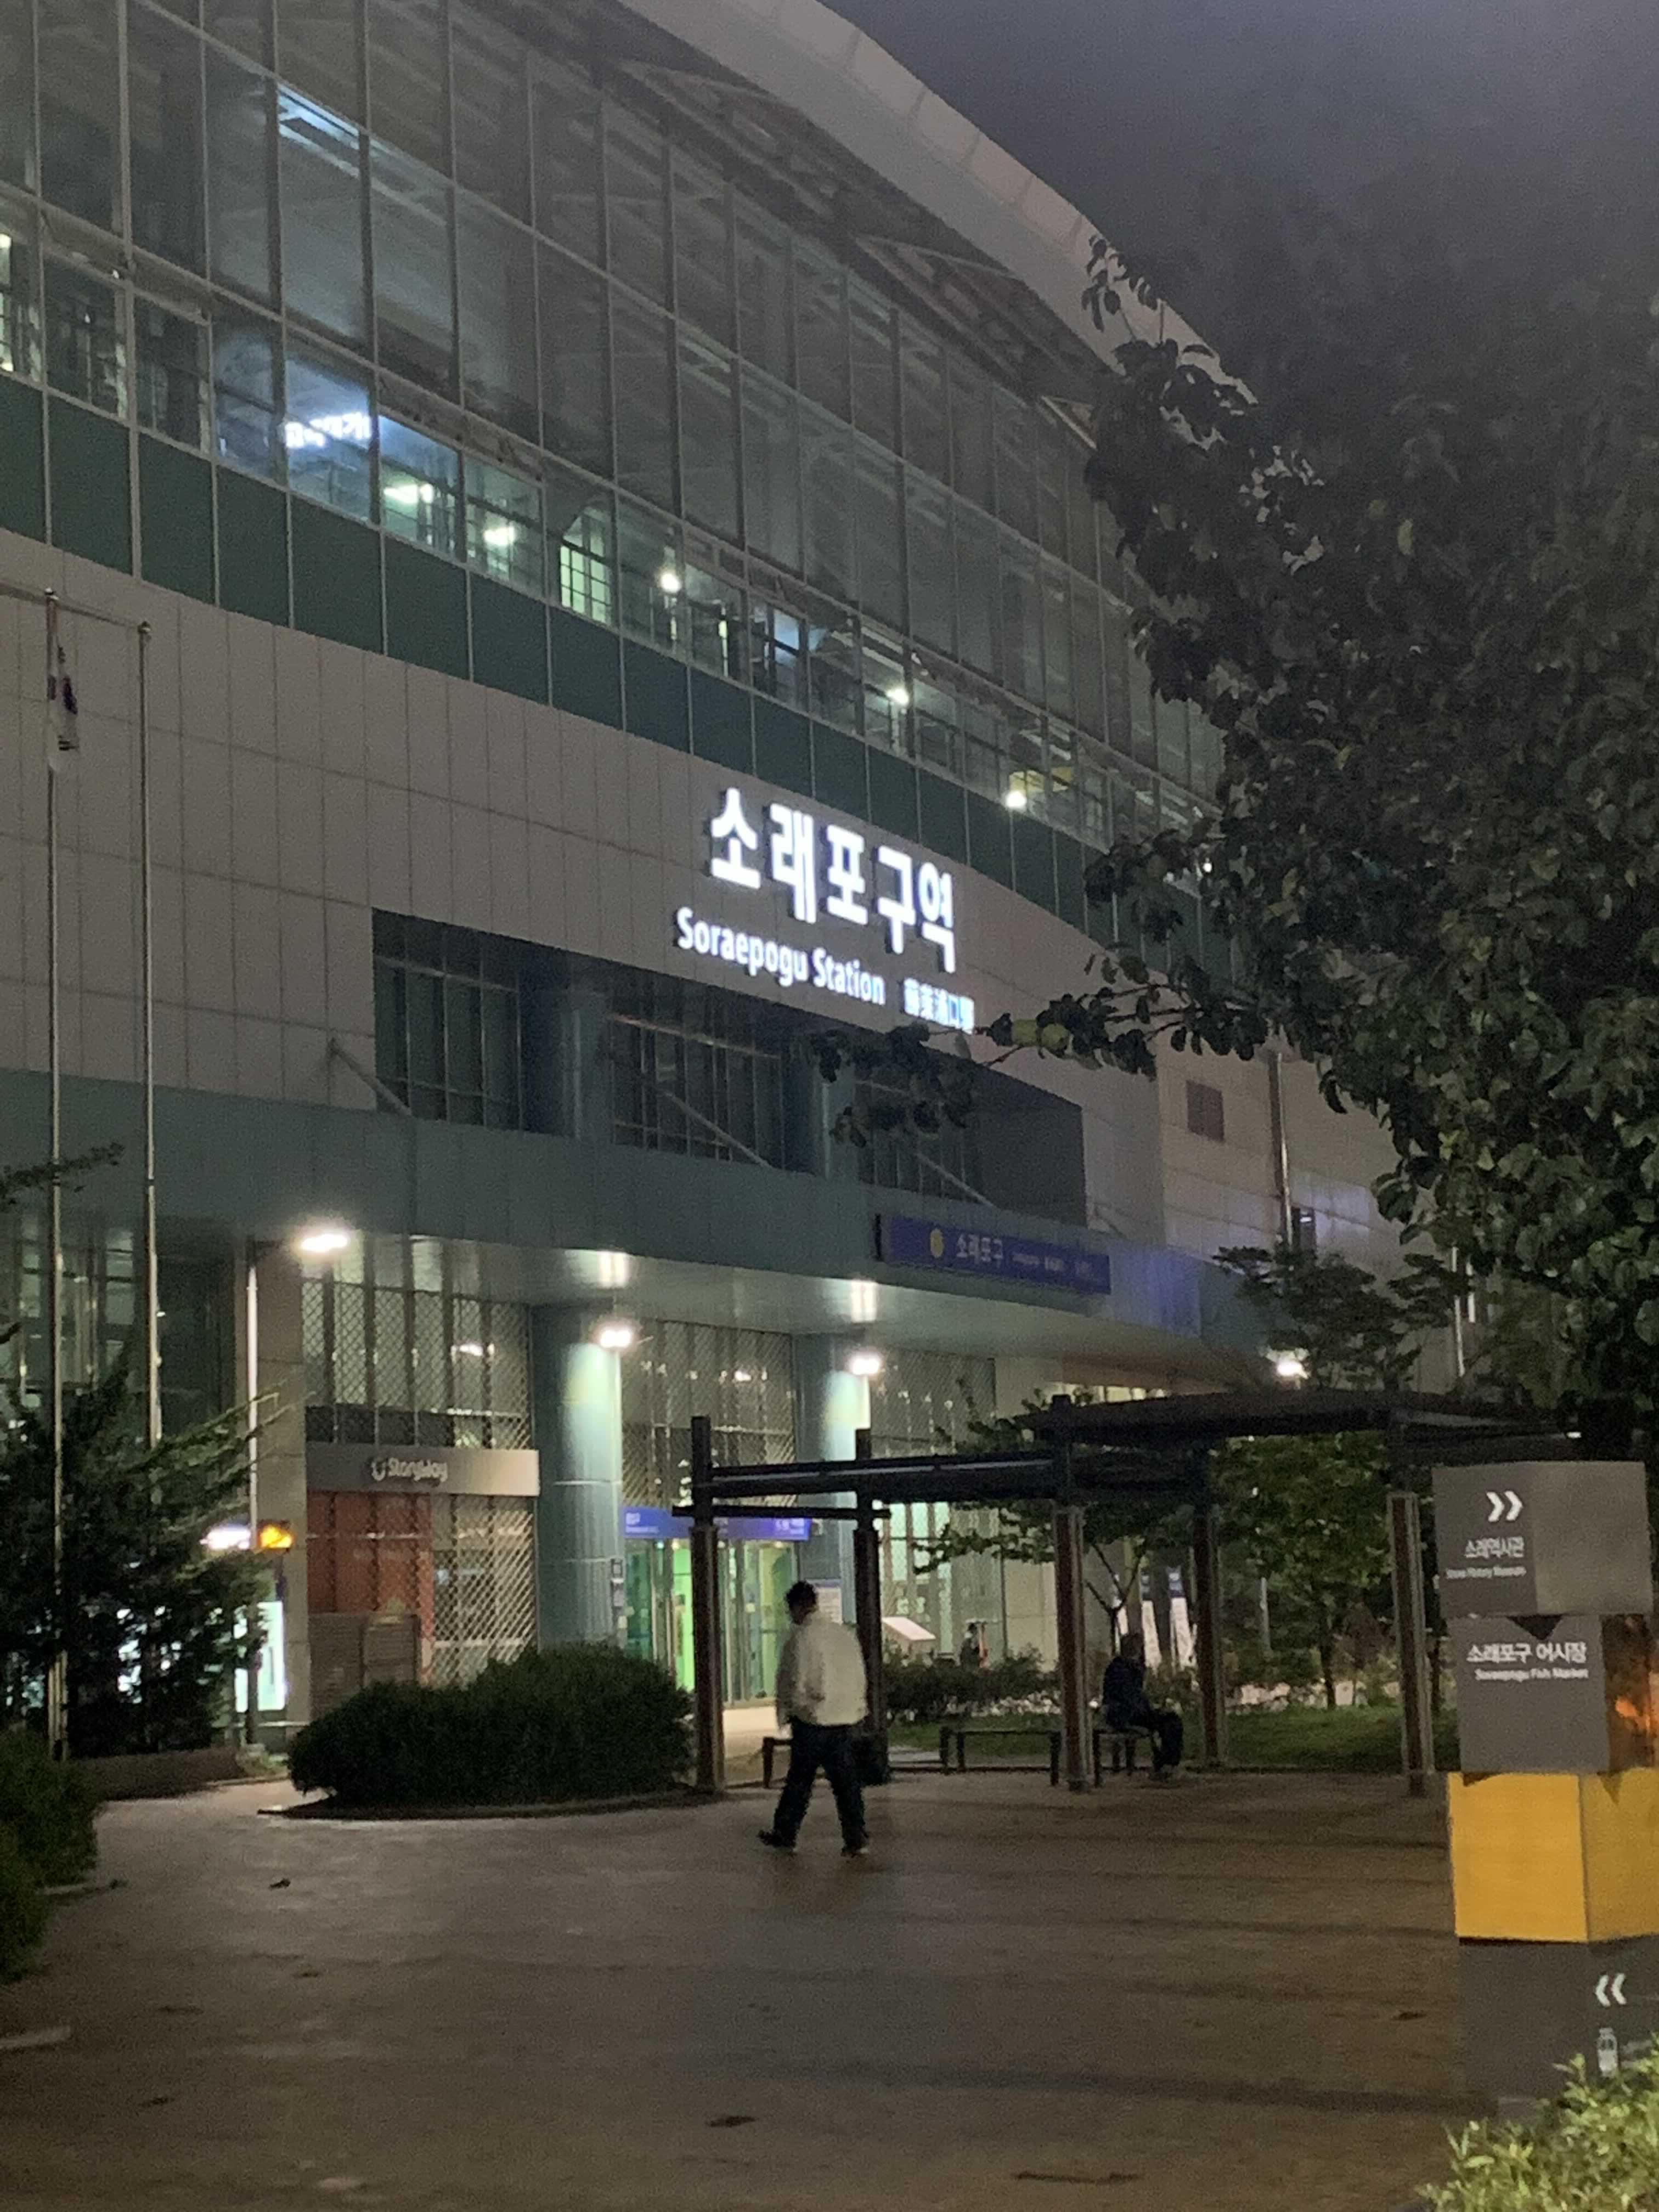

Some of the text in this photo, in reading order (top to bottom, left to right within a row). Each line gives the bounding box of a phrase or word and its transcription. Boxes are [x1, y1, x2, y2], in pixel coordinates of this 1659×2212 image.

[711, 788, 956, 973] 소래포구역
[676, 907, 886, 1006] Soraepogu Station
[1466, 1641, 1587, 1664] 소래포구 어시장
